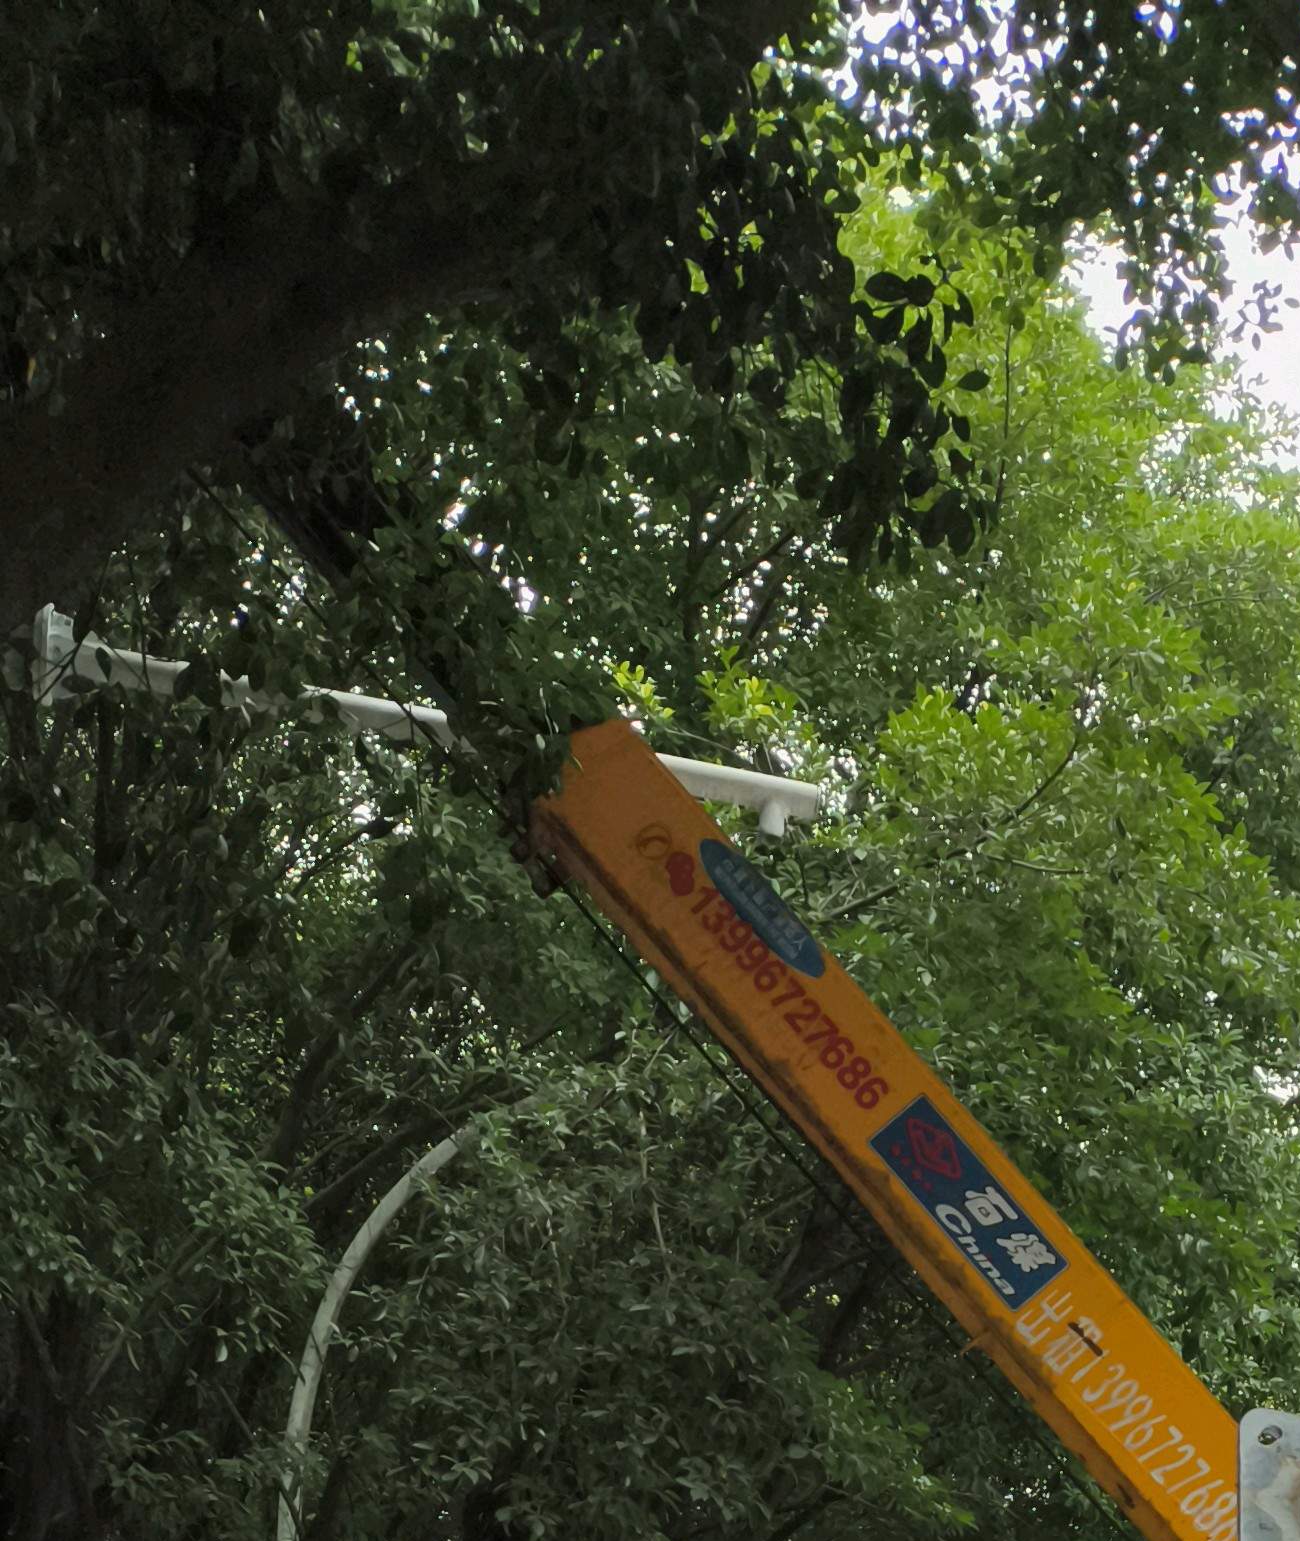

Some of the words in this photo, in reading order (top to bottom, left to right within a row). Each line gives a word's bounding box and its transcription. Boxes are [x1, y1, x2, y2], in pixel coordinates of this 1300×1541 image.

[692, 887, 888, 1109] 13996727686
[935, 1203, 1015, 1296] China
[964, 1186, 1056, 1272] 石煤
